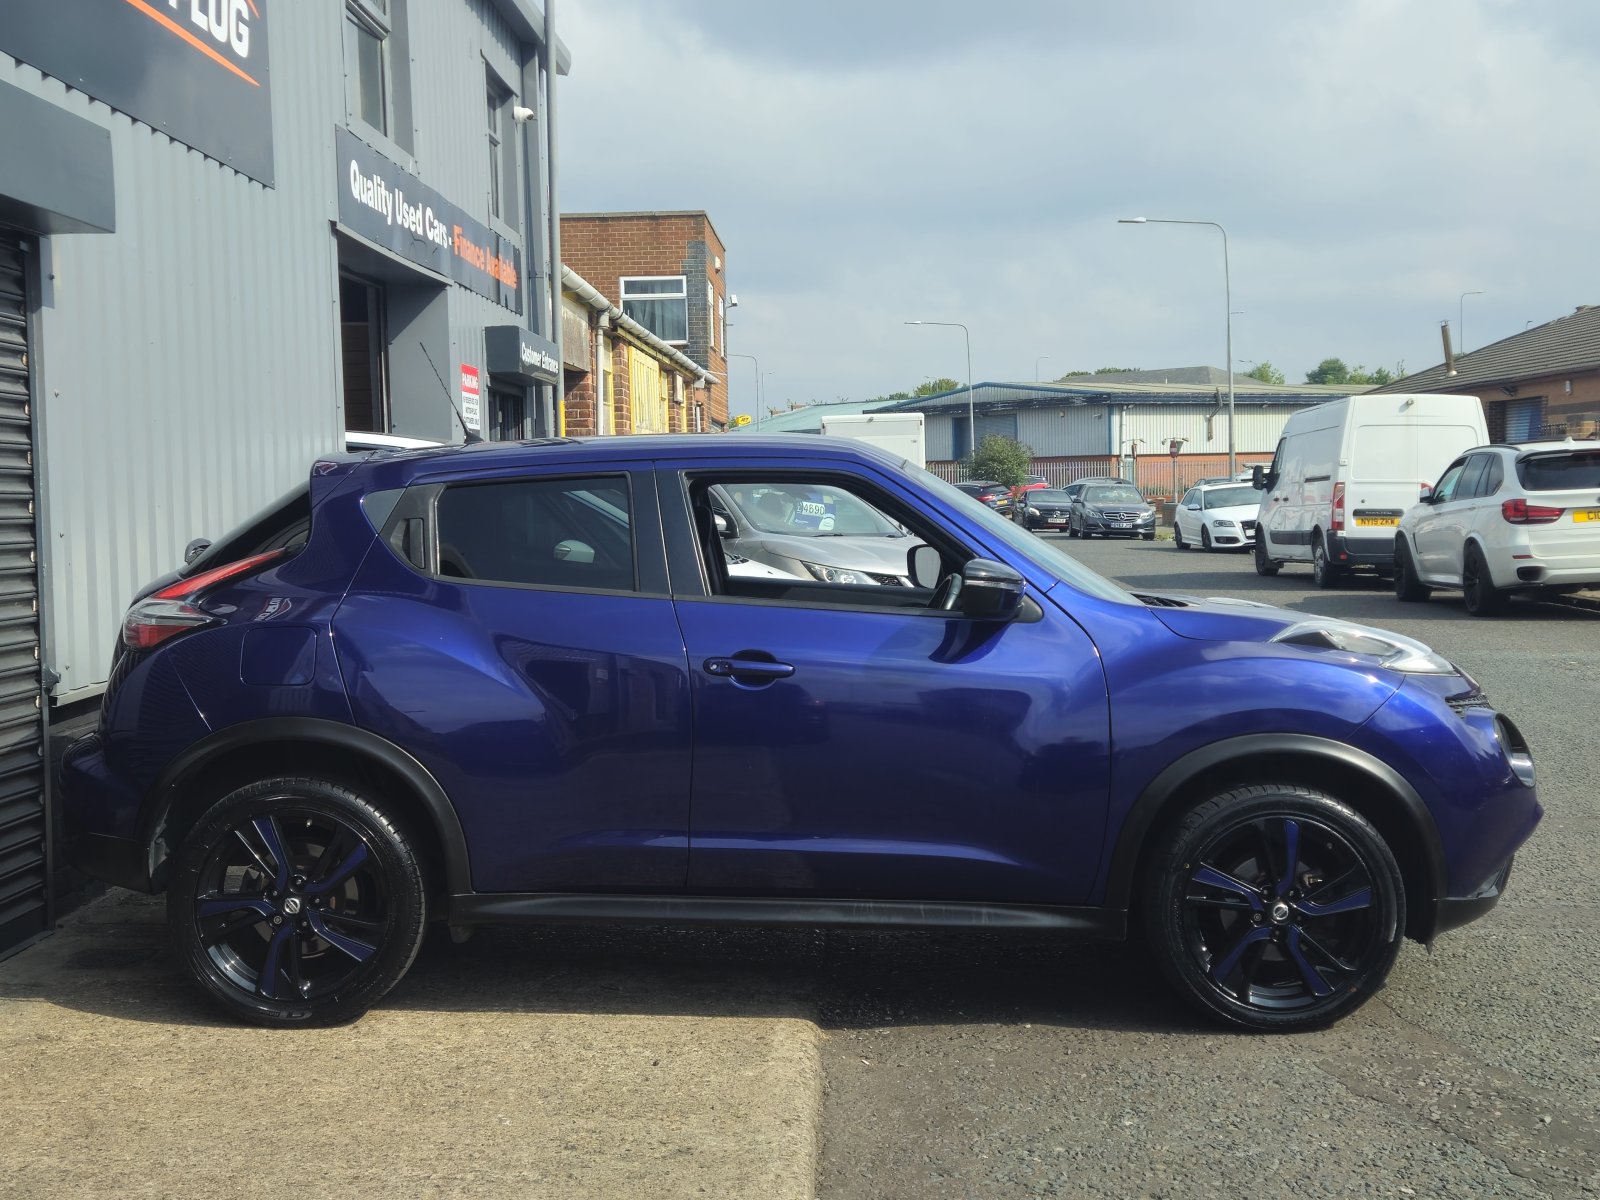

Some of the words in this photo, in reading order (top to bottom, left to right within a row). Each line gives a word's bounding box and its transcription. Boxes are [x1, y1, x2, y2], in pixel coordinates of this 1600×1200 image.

[350, 160, 393, 225] Quality
[395, 188, 423, 236] Used
[426, 206, 447, 248] Cars
[453, 224, 485, 271] Finance
[486, 244, 517, 289] Available
